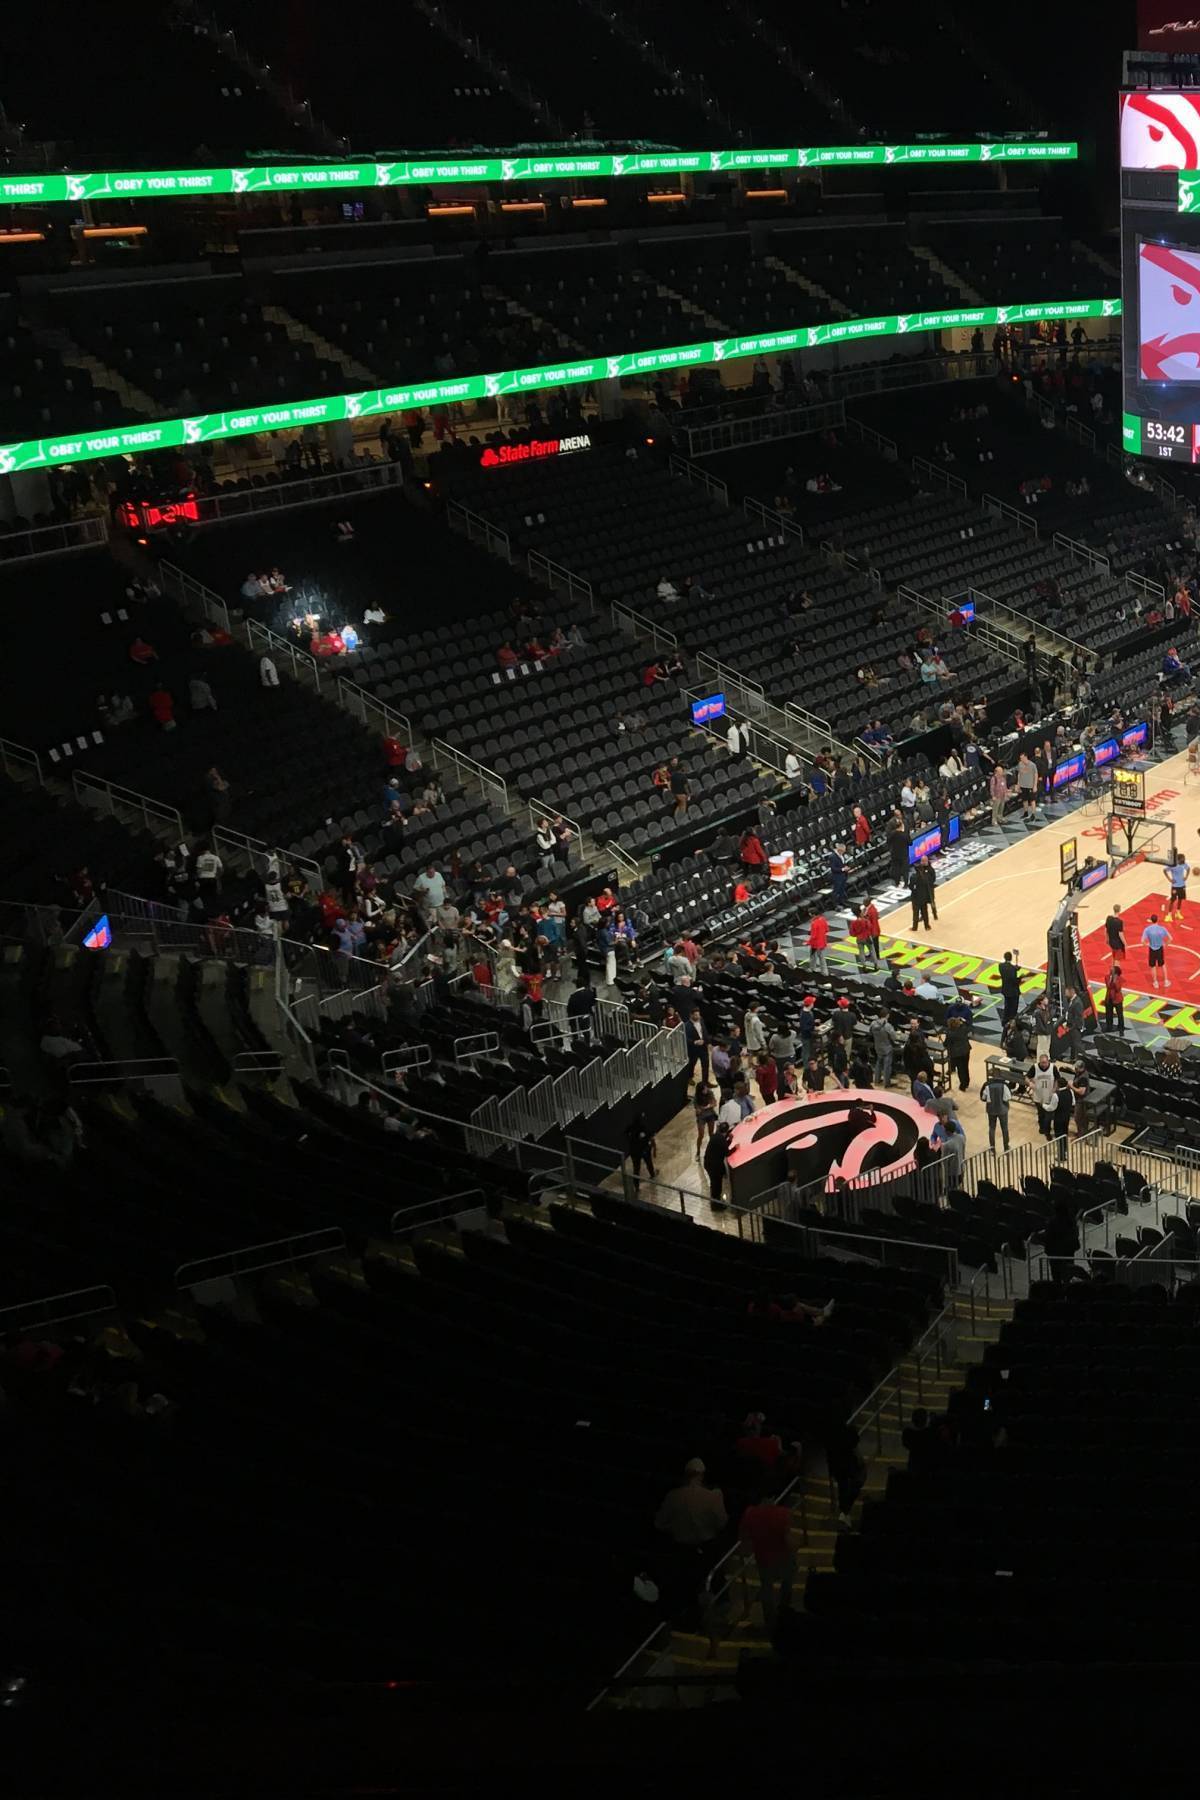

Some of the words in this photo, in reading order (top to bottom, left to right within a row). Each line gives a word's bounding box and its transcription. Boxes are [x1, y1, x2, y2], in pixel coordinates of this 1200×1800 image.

[820, 152, 835, 161] OBEY
[835, 151, 853, 160] YOUR
[852, 150, 874, 159] THIRST
[909, 149, 927, 158] OBEY
[927, 149, 947, 157] YOUR
[946, 148, 969, 157] THIRST
[1007, 147, 1026, 156] OBEY
[1027, 147, 1047, 155] YOUR
[1047, 147, 1070, 155] THIRST
[640, 159, 658, 169] OBEY
[659, 158, 678, 167] YOUR
[677, 157, 700, 167] THIRST
[735, 155, 752, 164] OBEY
[752, 154, 771, 163] YOUR
[769, 153, 789, 162] THIRST
[412, 167, 435, 178] OBEY
[436, 166, 460, 177] YOUR
[459, 165, 487, 176] THIRST
[533, 163, 554, 173] OBEY
[555, 161, 576, 172] YOUR
[575, 161, 600, 171] THIRST
[114, 178, 144, 191] OBEY
[146, 177, 176, 189] YOUR
[177, 175, 213, 187] THIRST
[273, 172, 299, 184] OBEY
[301, 171, 328, 183] YOUR
[328, 170, 360, 181] THIRST
[3, 182, 44, 195] THIRST
[1024, 308, 1043, 317] OBEY
[1044, 306, 1064, 315] YOUR
[1065, 305, 1090, 314] THIRST
[923, 316, 941, 325] OBEY
[941, 314, 960, 323] YOUR
[960, 312, 985, 321] THIRST
[831, 327, 847, 337] OBEY
[847, 324, 864, 334] YOUR
[863, 321, 886, 331] THIRST
[740, 340, 758, 351] OBEY
[758, 337, 778, 348] YOUR
[776, 334, 797, 345] THIRST
[637, 356, 657, 367] OBEY
[658, 352, 678, 364] YOUR
[678, 349, 702, 360] THIRST
[520, 373, 542, 385] OBEY
[543, 369, 566, 381] YOUR
[566, 365, 594, 377] THIRST
[385, 392, 410, 406] OBEY
[412, 388, 438, 401] YOUR
[438, 383, 469, 397] THIRST
[230, 415, 259, 429] OBEY
[262, 410, 291, 424] YOUR
[292, 404, 327, 419] THIRST
[1146, 422, 1186, 443] 53:42
[49, 441, 83, 457] OBEY
[85, 435, 120, 451] YOUR
[121, 429, 162, 445] THIRST
[560, 434, 592, 452] ARENA
[1158, 446, 1173, 457] 1ST
